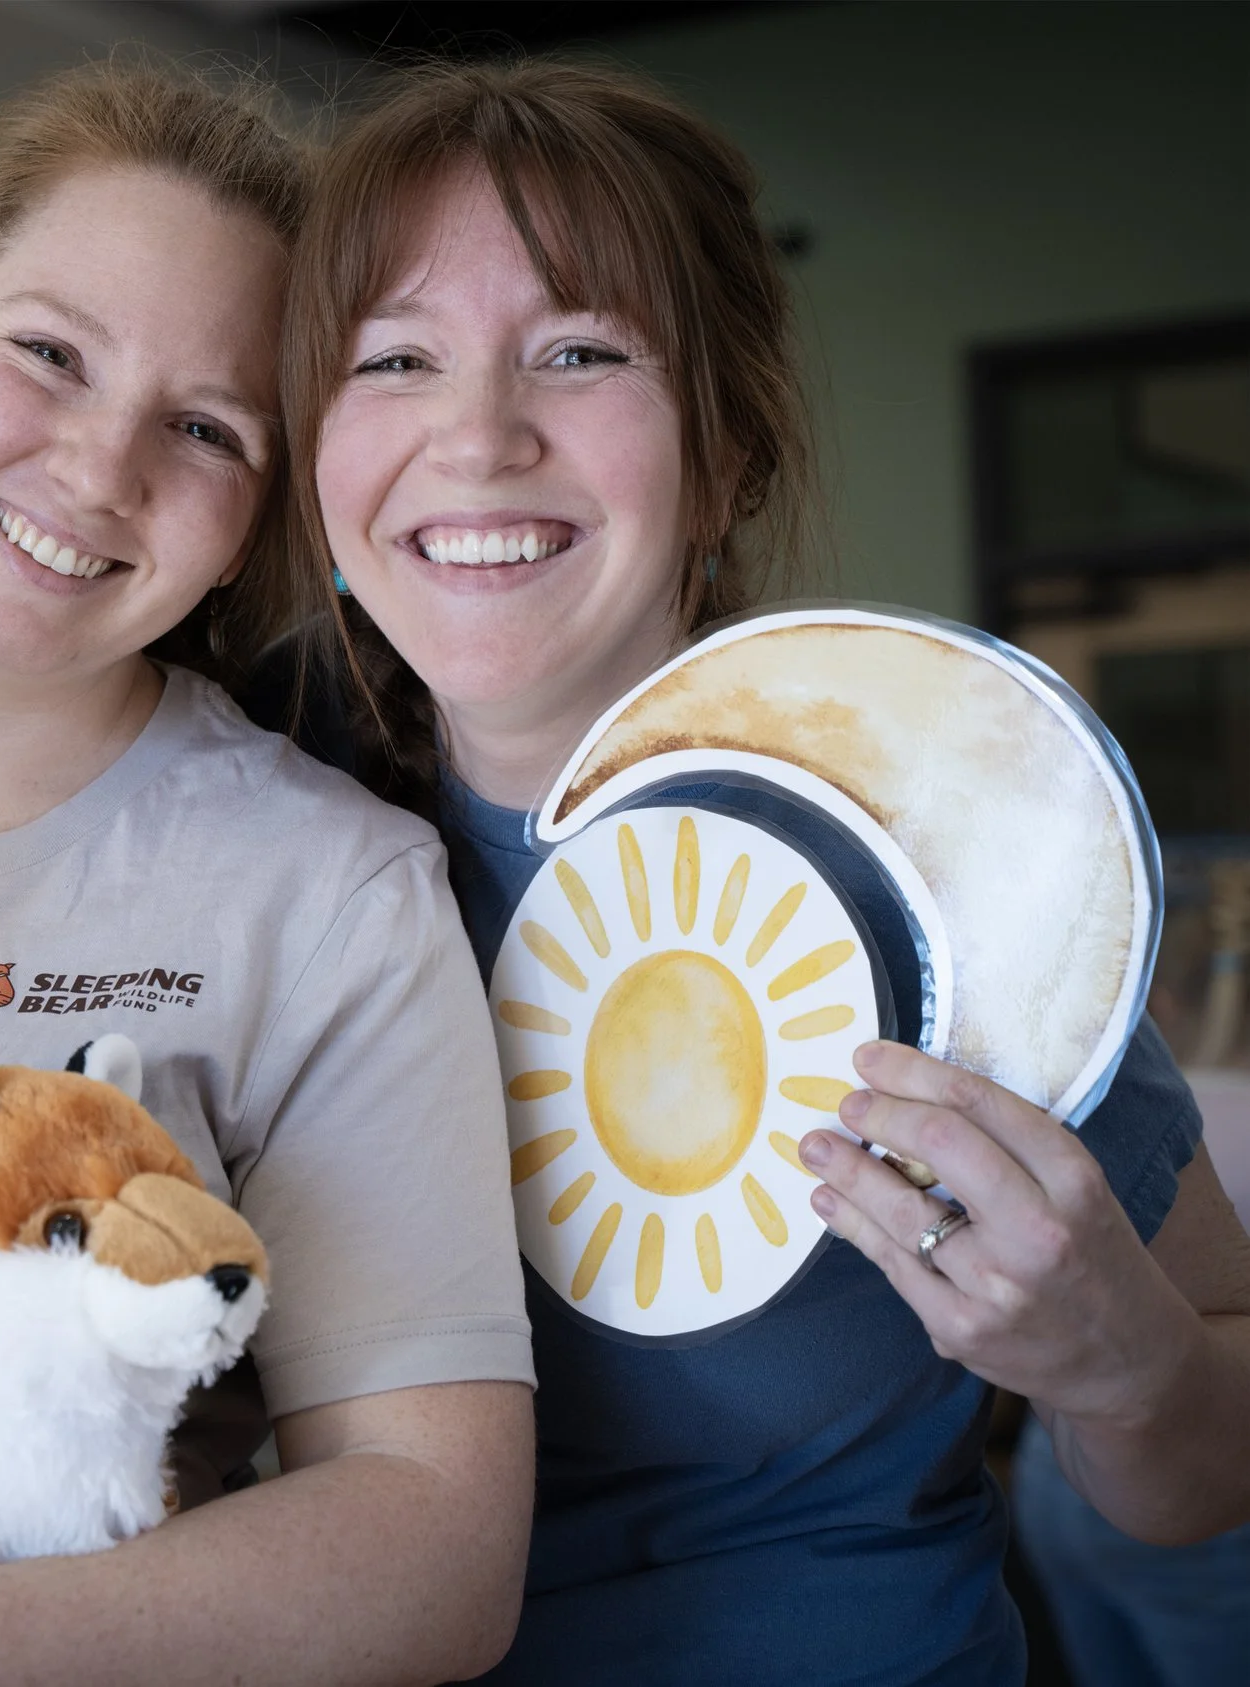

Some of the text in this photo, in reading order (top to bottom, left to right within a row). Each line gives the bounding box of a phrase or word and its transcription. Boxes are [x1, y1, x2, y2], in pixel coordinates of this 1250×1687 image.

[29, 968, 204, 994] SLEEPING
[17, 994, 115, 1014] BEAR
[113, 999, 157, 1012] FUND
[118, 989, 195, 1008] WILDLIFE
